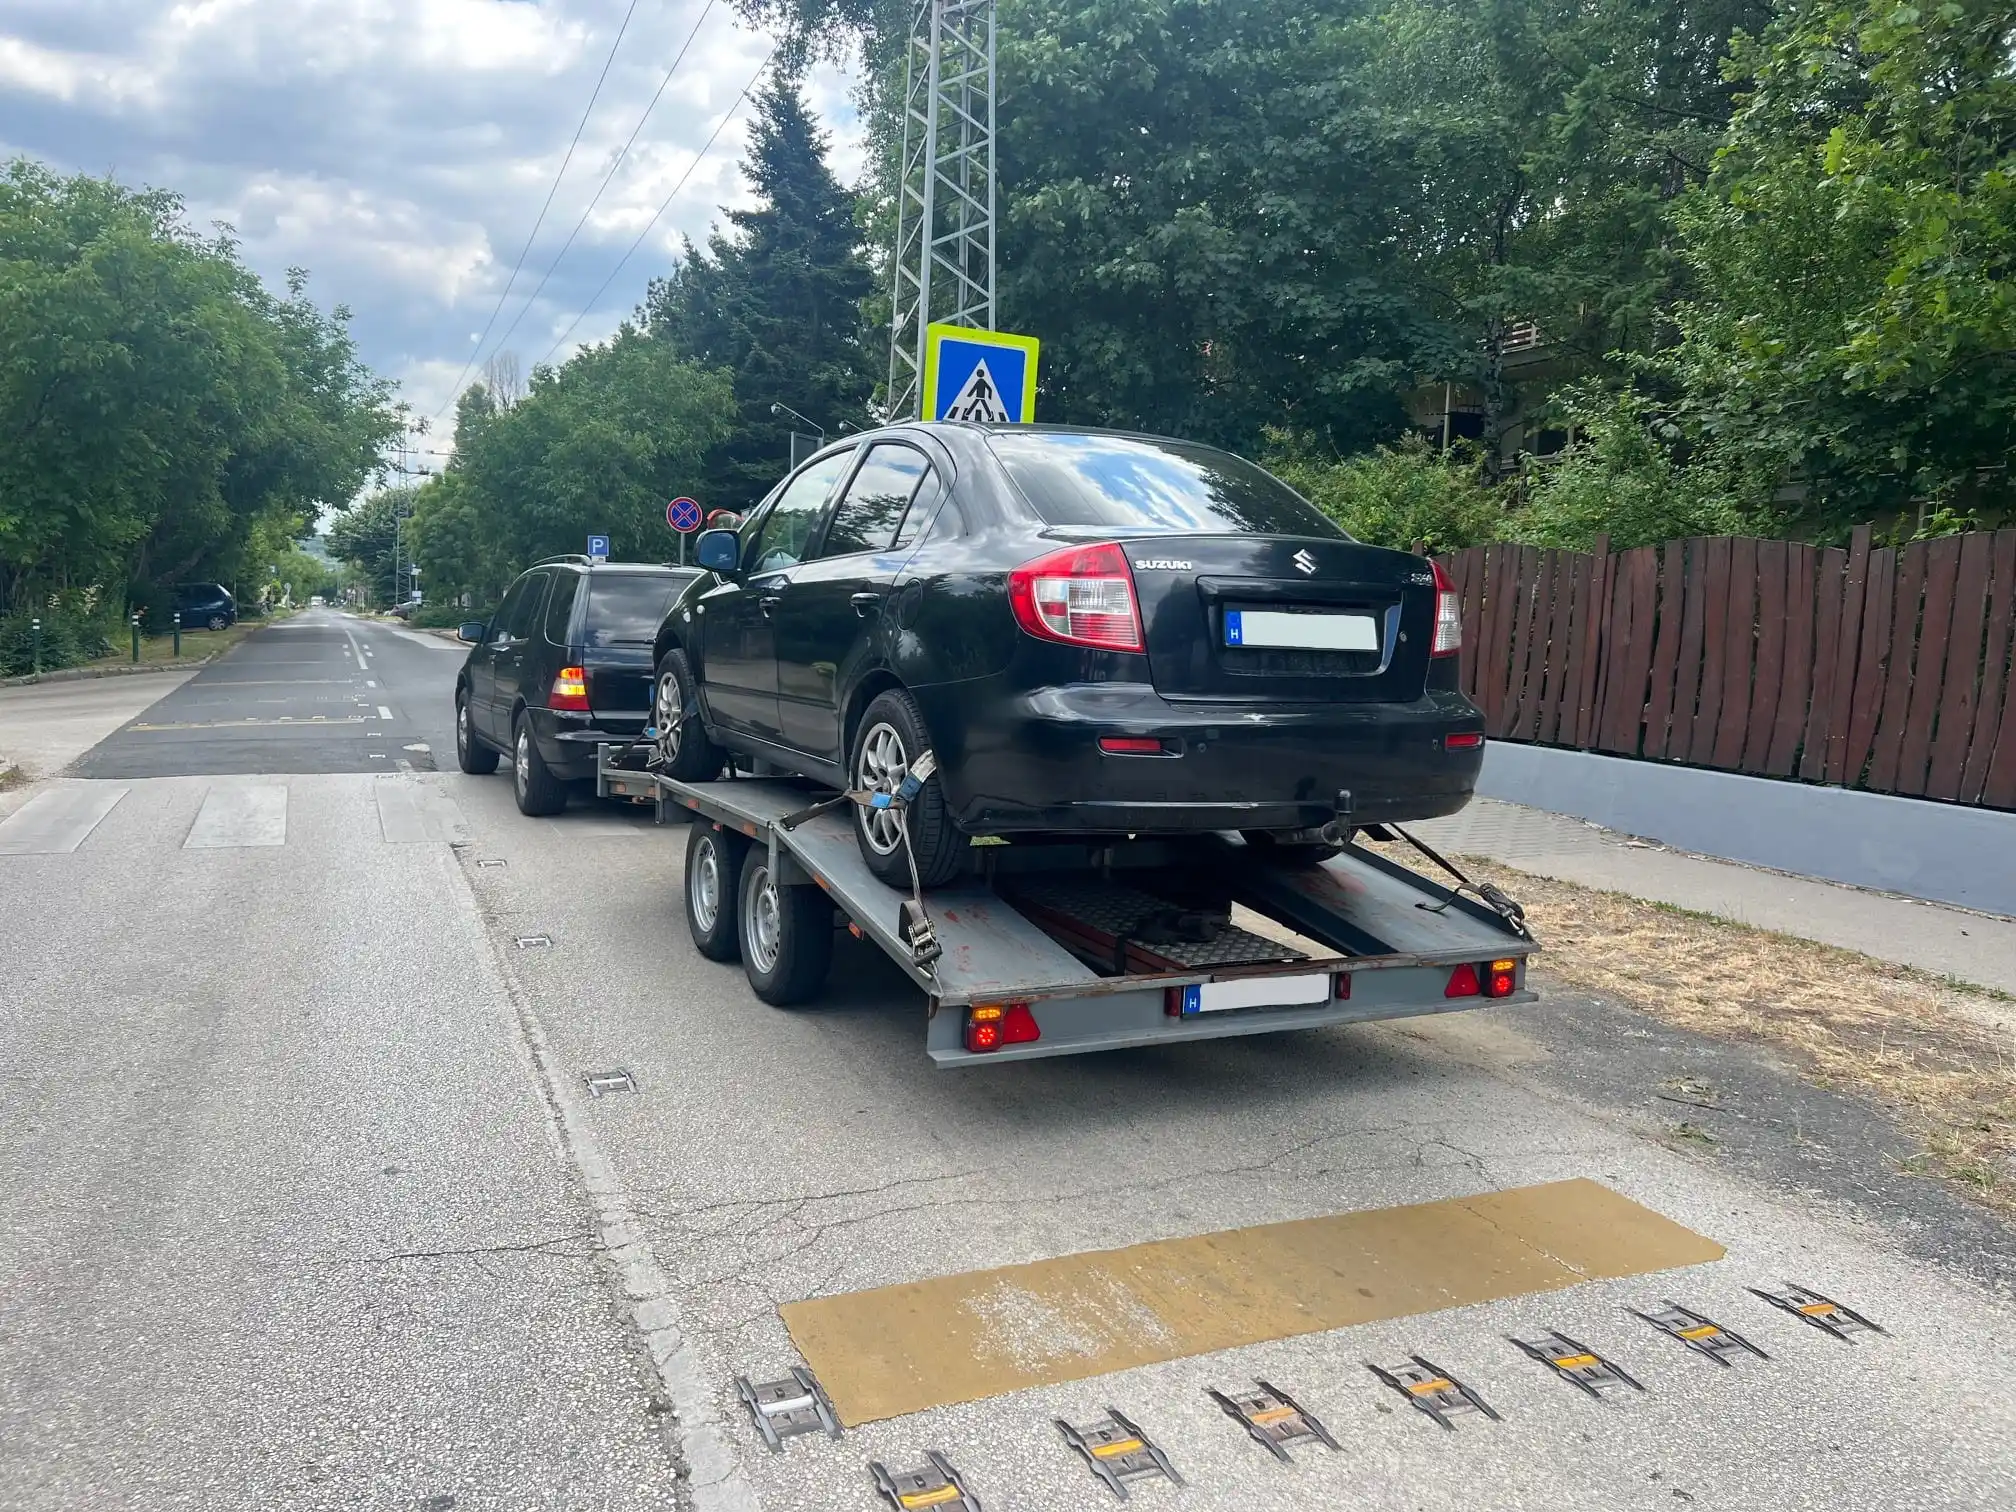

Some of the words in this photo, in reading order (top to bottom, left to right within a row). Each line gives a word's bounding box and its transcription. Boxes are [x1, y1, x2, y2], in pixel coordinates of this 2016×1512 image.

[592, 539, 604, 553] P
[1135, 559, 1192, 571] SUZUKI
[1231, 628, 1239, 640] H
[1190, 998, 1197, 1009] H
